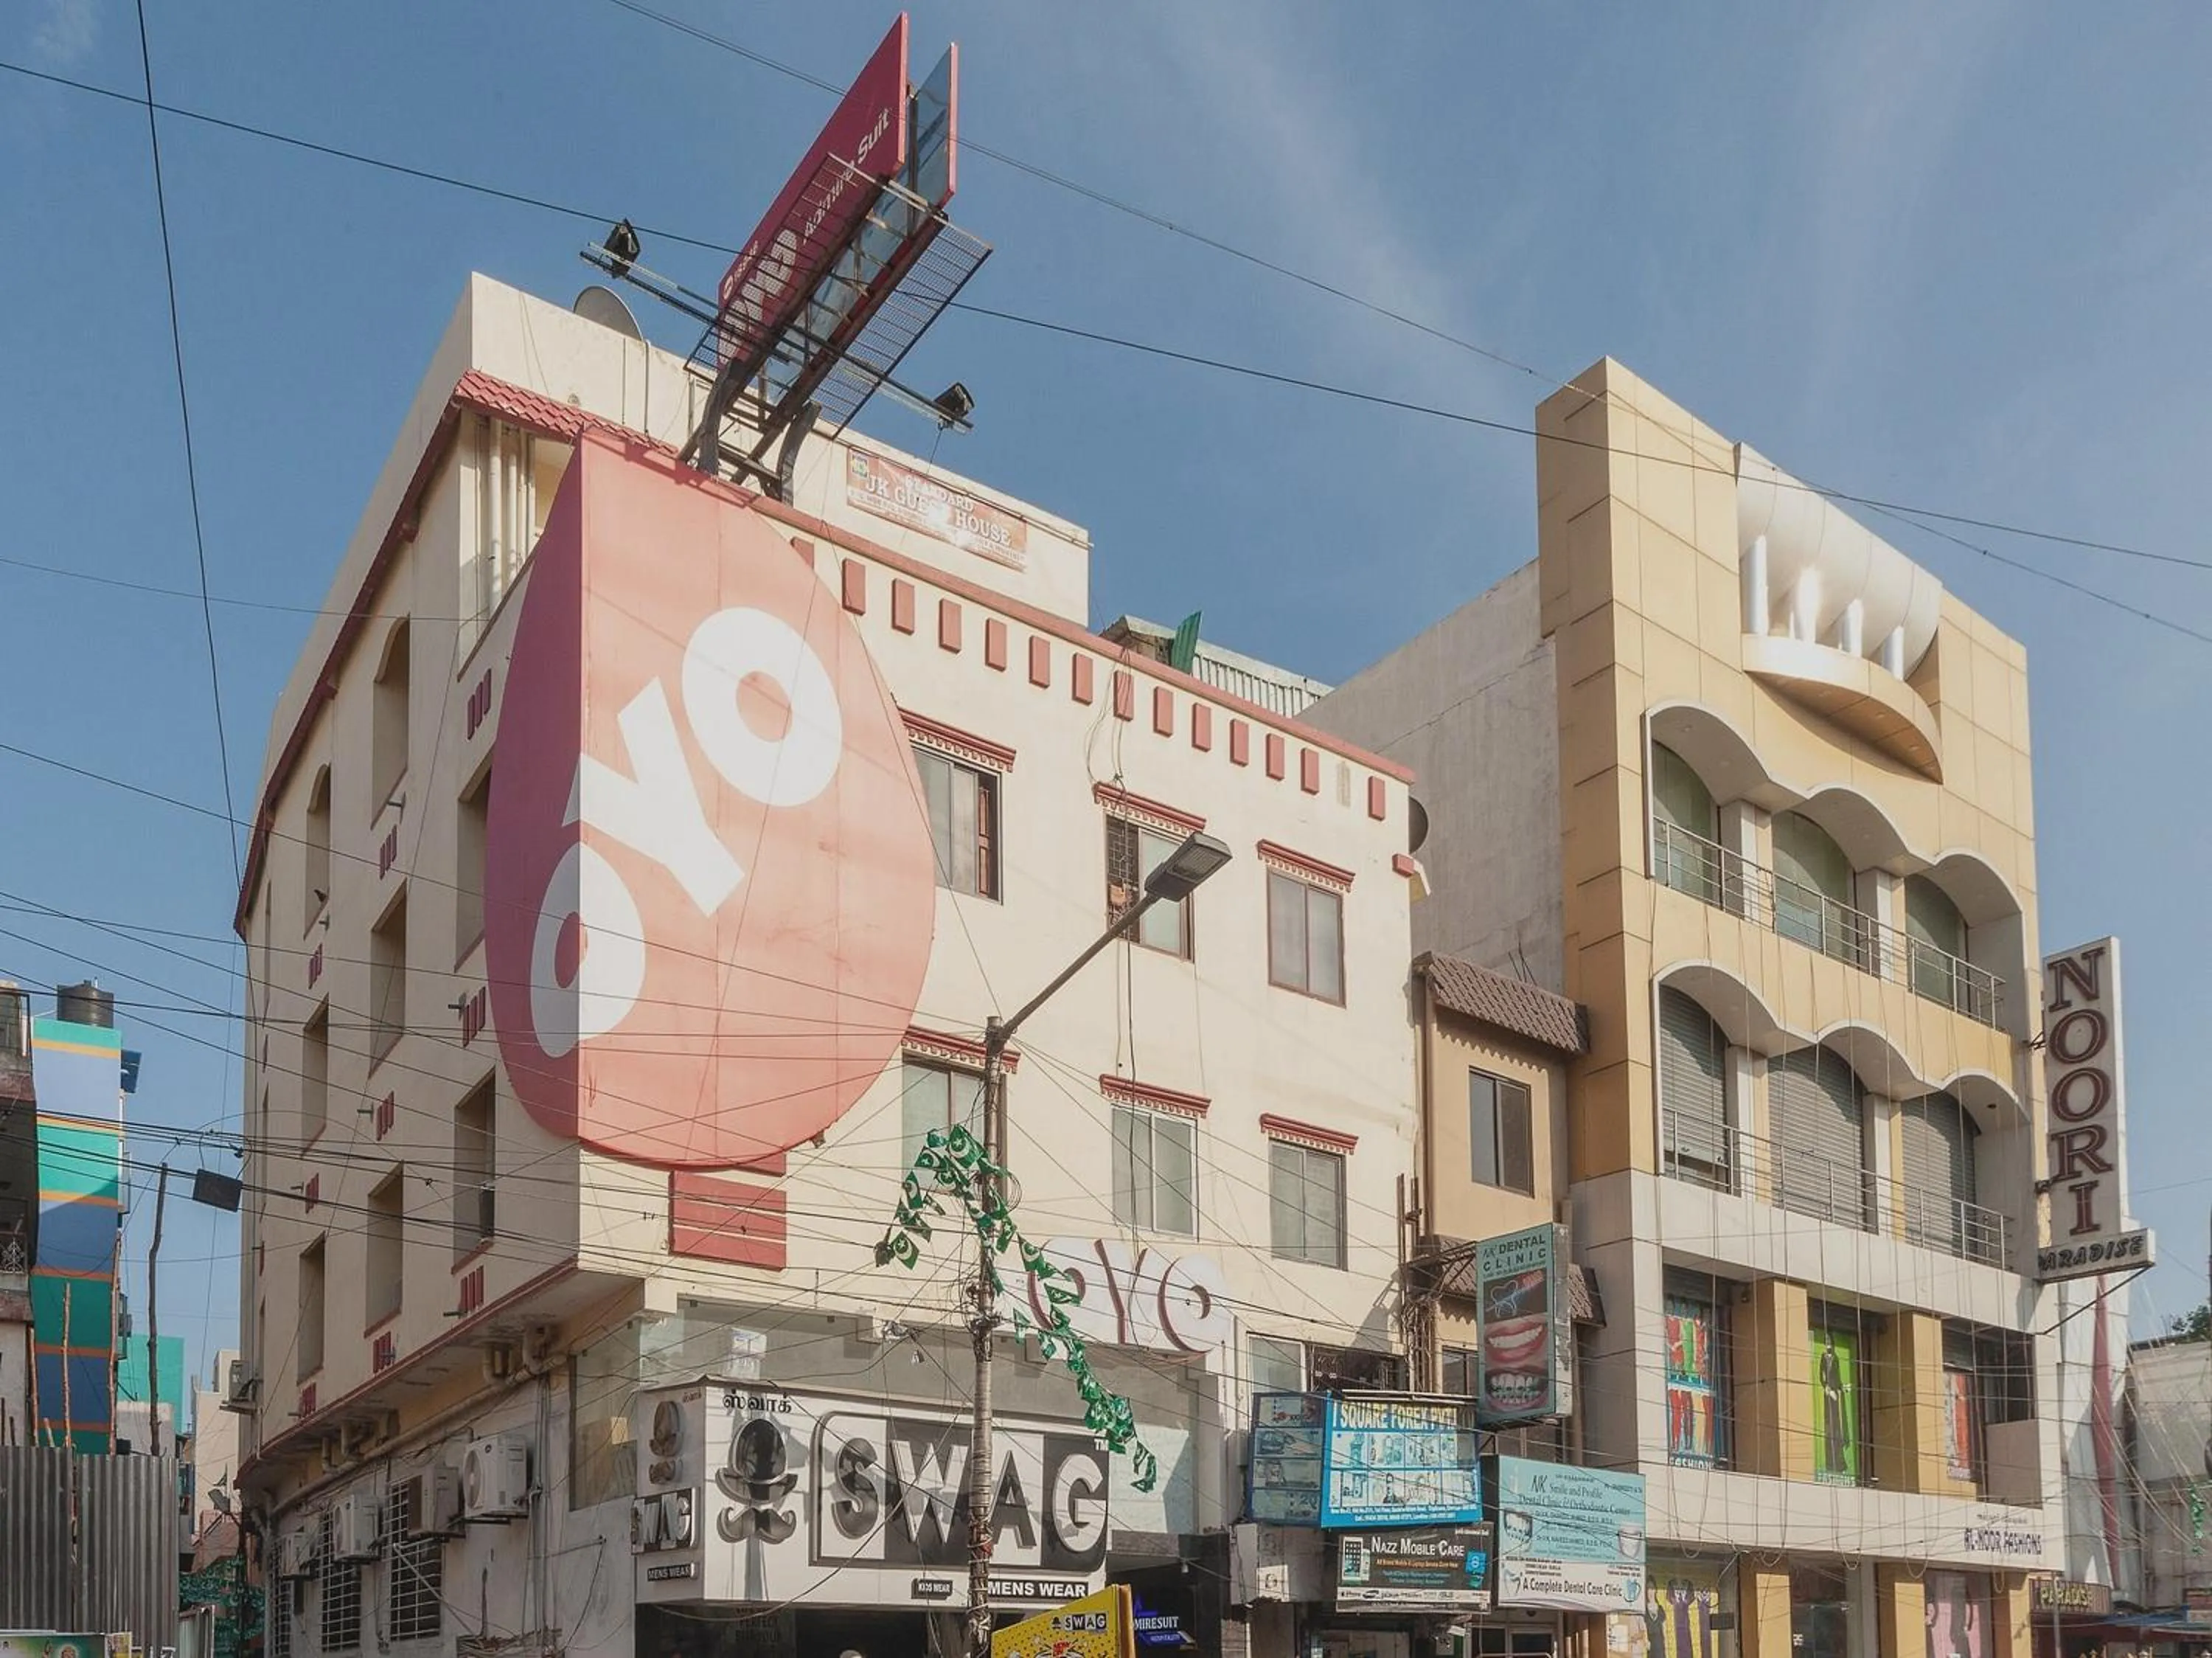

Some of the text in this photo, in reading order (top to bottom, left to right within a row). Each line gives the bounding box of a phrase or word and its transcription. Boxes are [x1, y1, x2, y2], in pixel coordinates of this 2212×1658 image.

[858, 108, 889, 165] Suit
[956, 509, 1012, 544] HOUSE
[530, 606, 843, 1058] OYO
[2046, 946, 2113, 1236] NOORI
[1499, 1233, 1546, 1254] DENTAL
[1483, 1248, 1546, 1272] CLINIC
[723, 1389, 792, 1414] ஸ்வாக்
[1340, 1401, 1388, 1429] SQUARE
[1391, 1403, 1427, 1429] FOREX
[831, 1437, 1105, 1552] SWAG
[1371, 1536, 1465, 1557] NAZZ MOBILE CARE
[987, 1581, 1086, 1598] MENS WEAR
[1523, 1578, 1528, 1590] A
[1530, 1578, 1562, 1595] Complete
[1564, 1581, 1585, 1595] Dental
[1587, 1582, 1603, 1595] Care
[1065, 1614, 1106, 1629] SWAG
